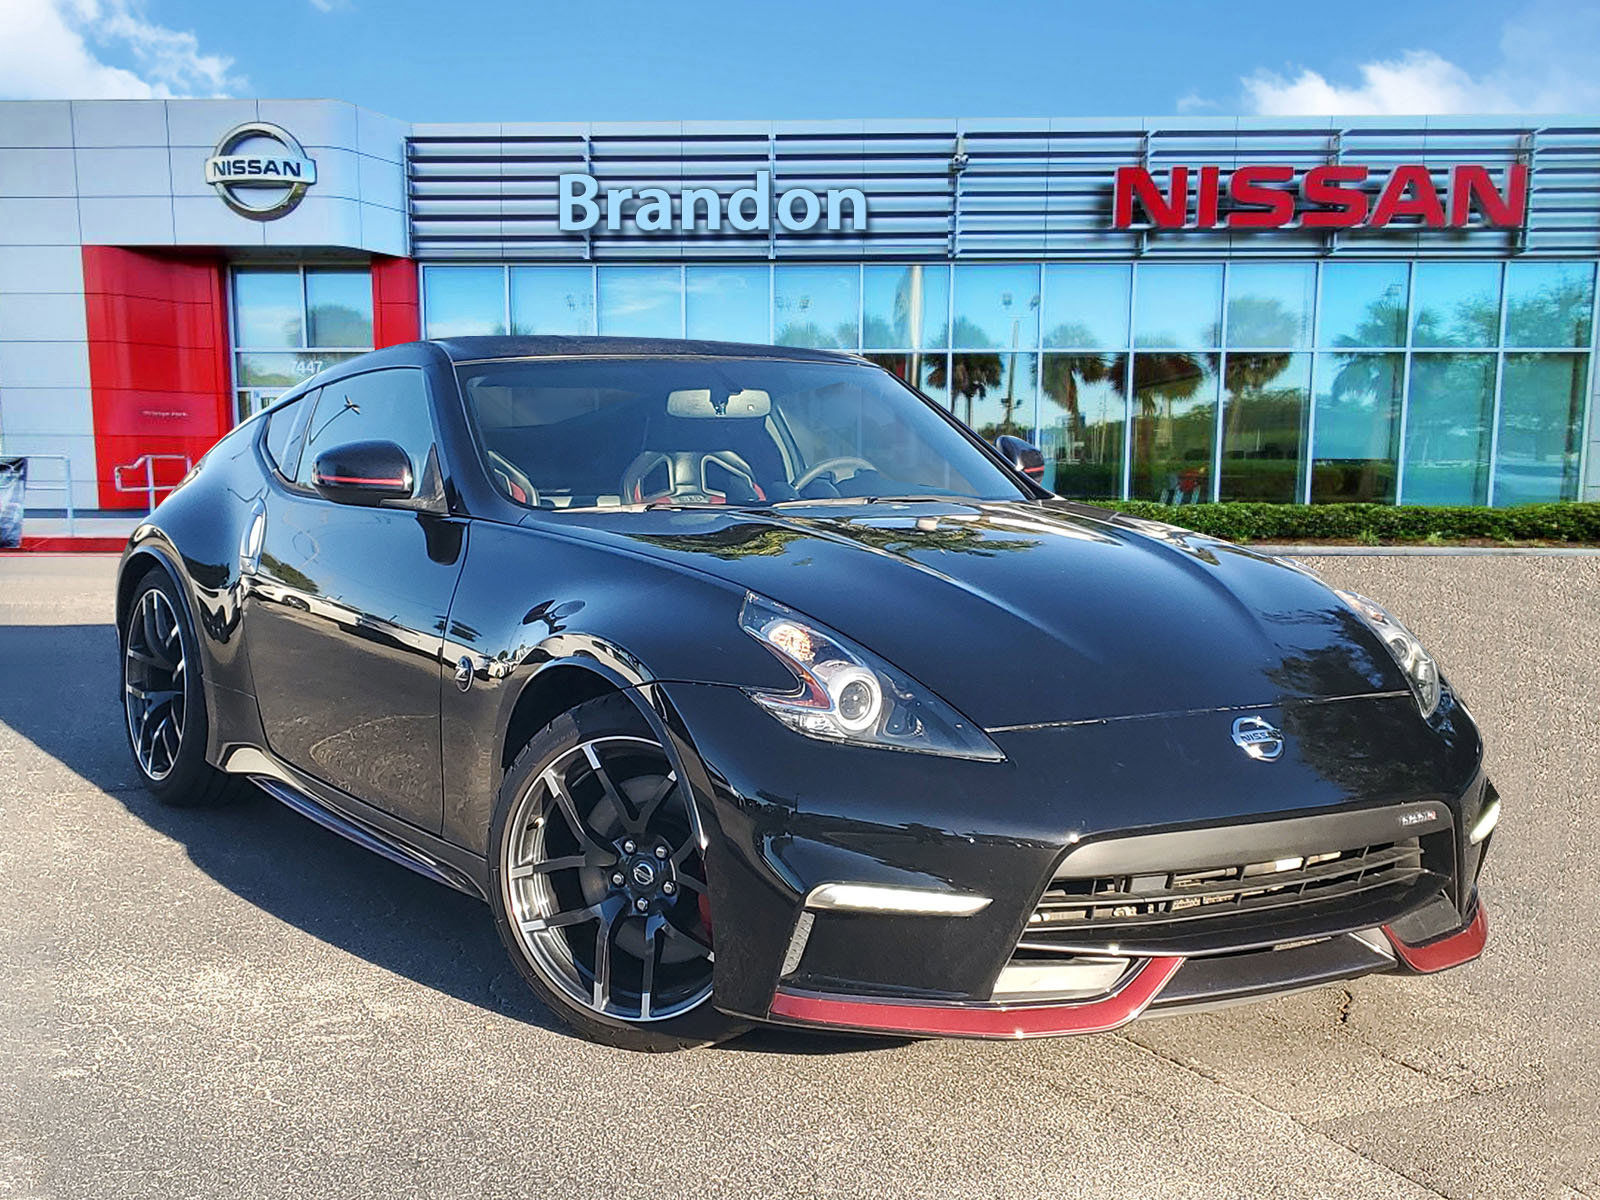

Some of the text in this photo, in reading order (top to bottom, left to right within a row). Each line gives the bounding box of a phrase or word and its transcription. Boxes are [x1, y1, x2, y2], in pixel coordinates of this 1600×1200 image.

[213, 160, 301, 177] NISSAN
[1112, 165, 1528, 229] NISSAN
[559, 170, 867, 231] Brandon
